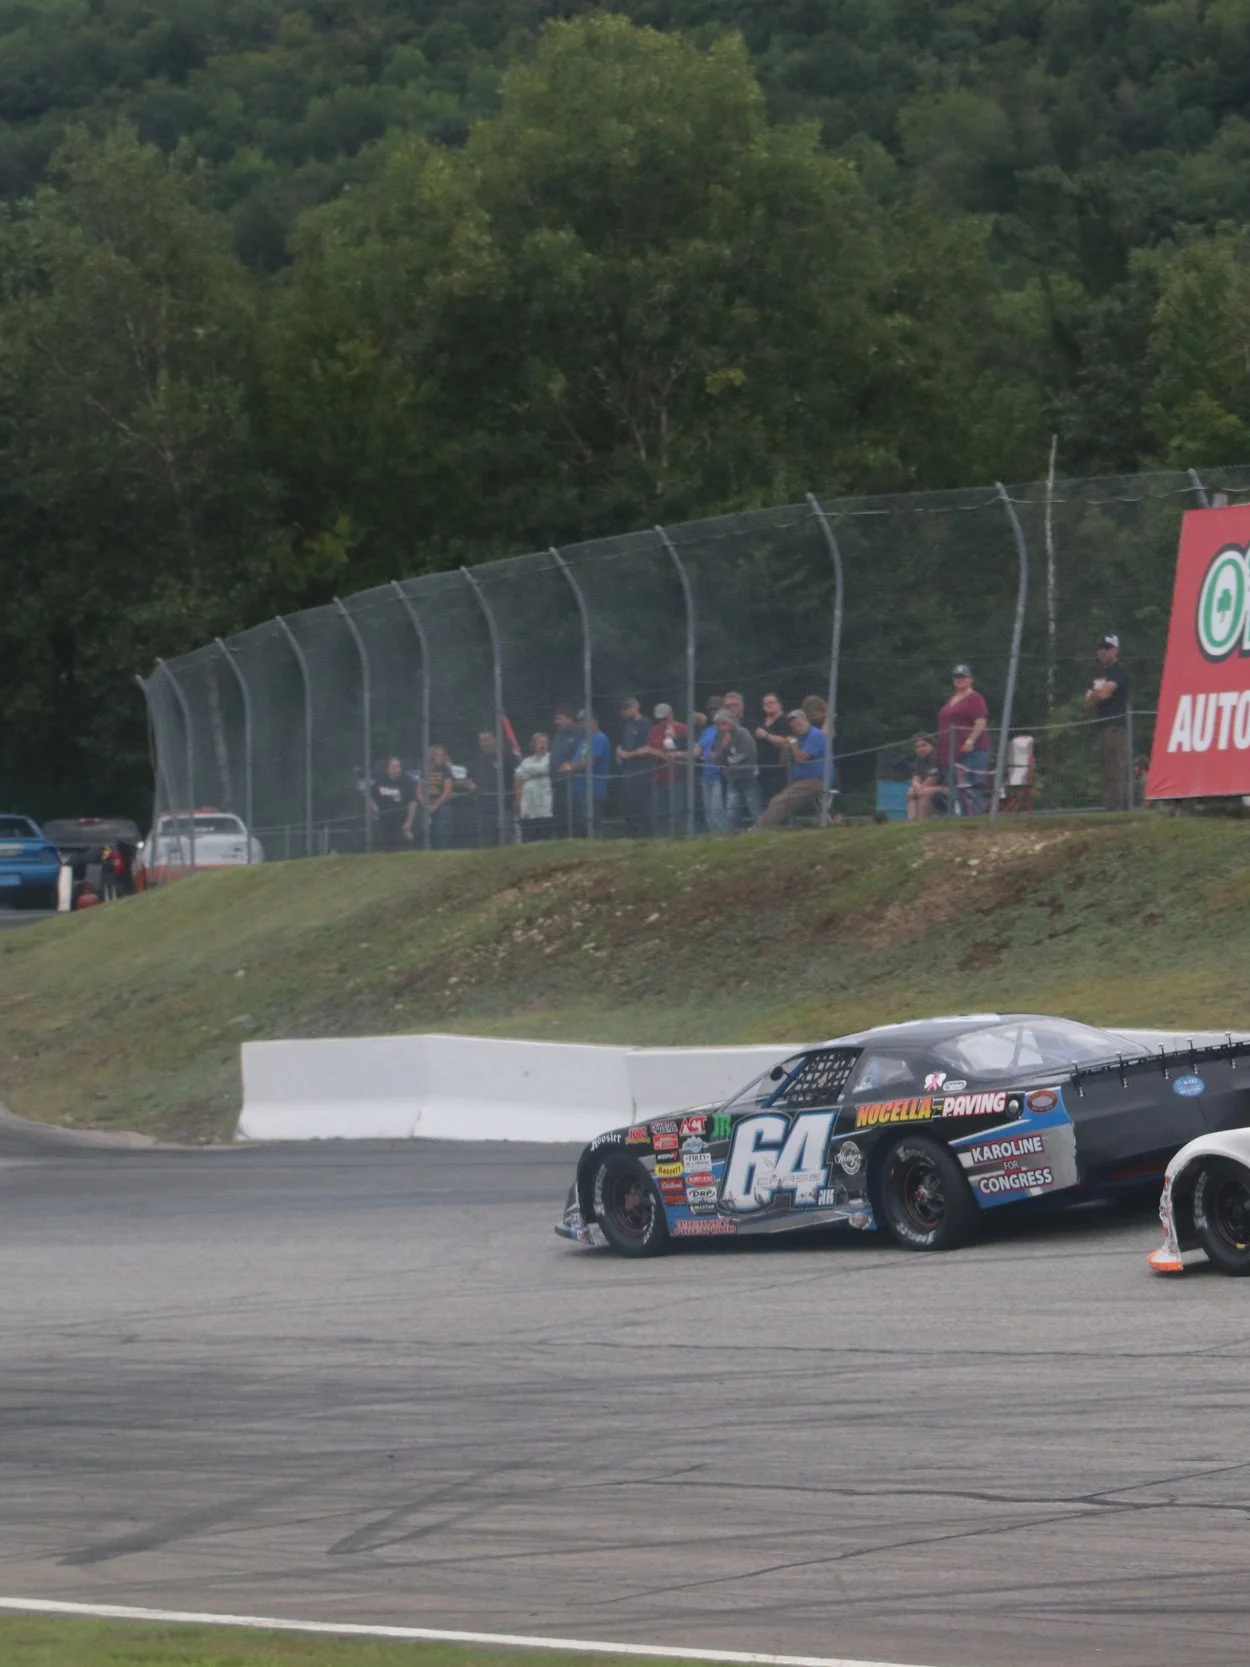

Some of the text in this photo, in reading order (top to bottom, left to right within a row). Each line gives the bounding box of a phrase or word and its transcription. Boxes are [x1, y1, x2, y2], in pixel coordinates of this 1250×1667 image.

[855, 1096, 933, 1129] NOCELLA
[942, 1091, 1008, 1118] PAVING
[711, 1113, 731, 1139] JR
[590, 1132, 622, 1152] Hoosier
[971, 1136, 1043, 1163] KAROLINE
[719, 1108, 838, 1213] 64
[1003, 1160, 1019, 1170] FOR
[979, 1168, 1053, 1194] CONGRESS
